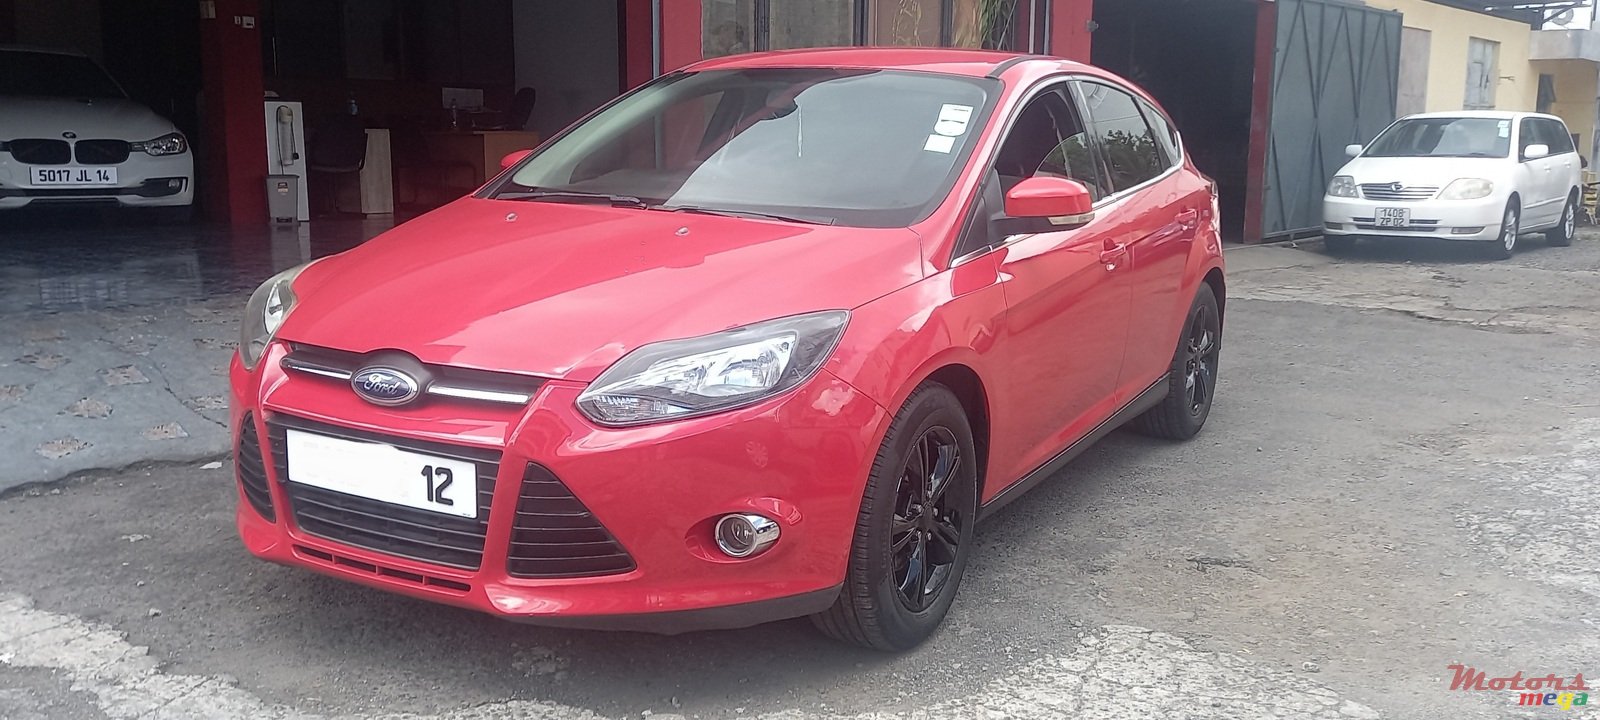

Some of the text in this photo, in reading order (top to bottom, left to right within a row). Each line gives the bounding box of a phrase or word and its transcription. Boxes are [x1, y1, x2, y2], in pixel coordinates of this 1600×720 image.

[38, 169, 110, 182] 5017 JL 14
[1380, 217, 1405, 227] ZP 02
[364, 373, 401, 395] Ford
[421, 465, 454, 506] 12
